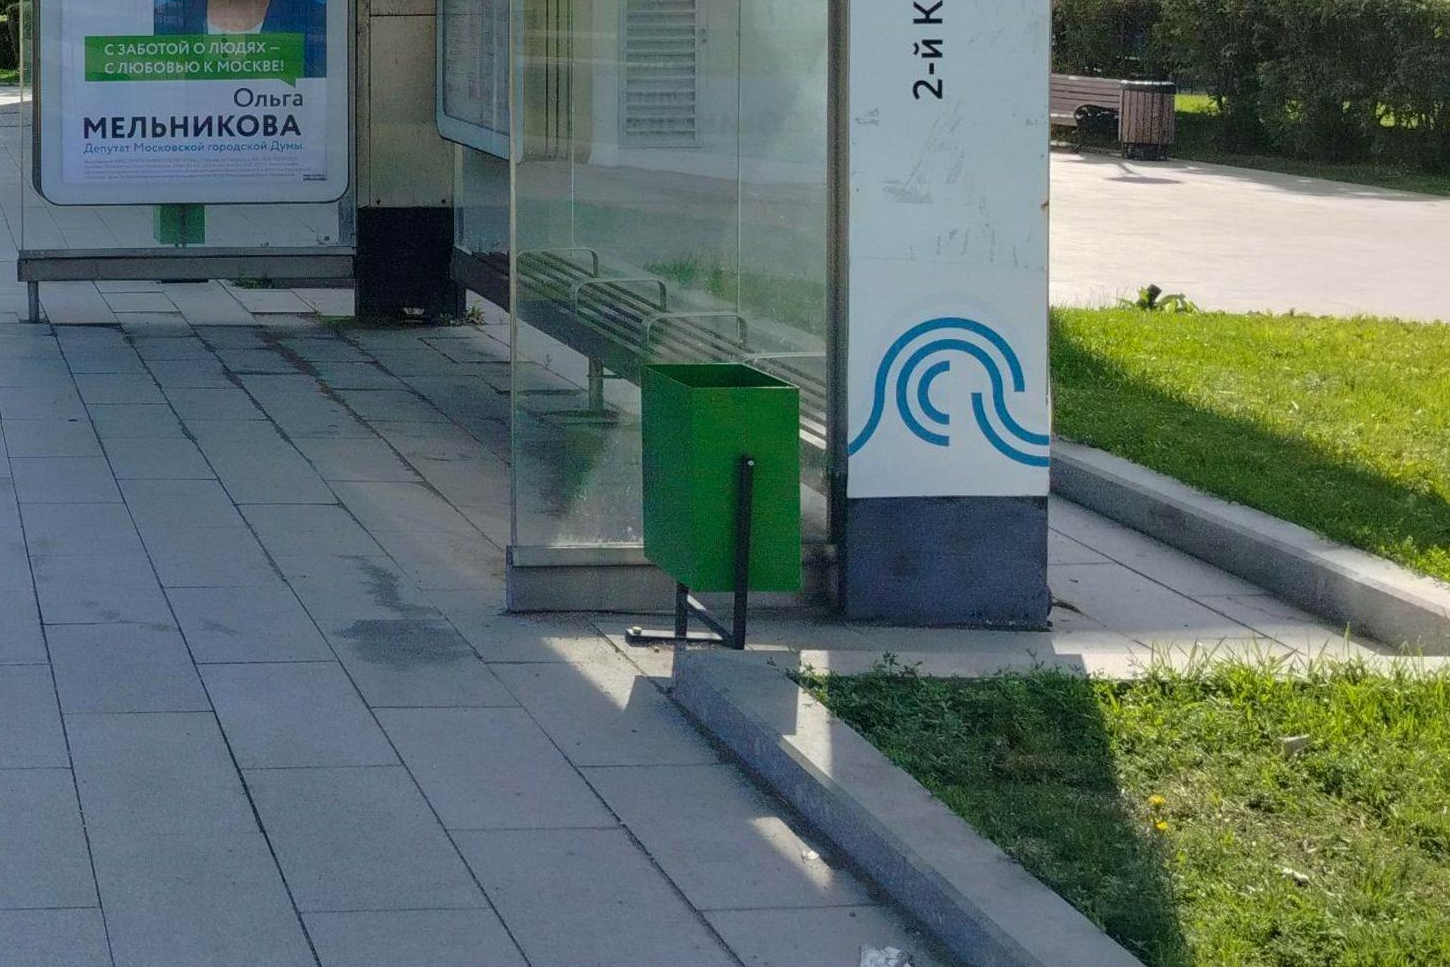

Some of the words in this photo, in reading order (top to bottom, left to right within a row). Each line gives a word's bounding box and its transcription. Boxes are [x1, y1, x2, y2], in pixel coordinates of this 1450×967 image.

[105, 44, 114, 55] С
[118, 41, 189, 55] ЗАБОТОЙ
[194, 43, 205, 54] О
[209, 42, 265, 54] ЛЮДЯХ
[105, 63, 114, 74] С
[116, 61, 199, 74] ЛЮБОВЬЮ
[205, 62, 213, 73] К
[217, 60, 284, 73] МОСКВЕ!
[913, 38, 943, 100] 2-й
[234, 88, 303, 108] Ольга
[83, 114, 301, 139] МЕЛЬНИКОВА
[83, 144, 129, 154] Депутат
[133, 142, 204, 152] Московской
[208, 141, 267, 153] городской
[270, 140, 302, 152] Думы
